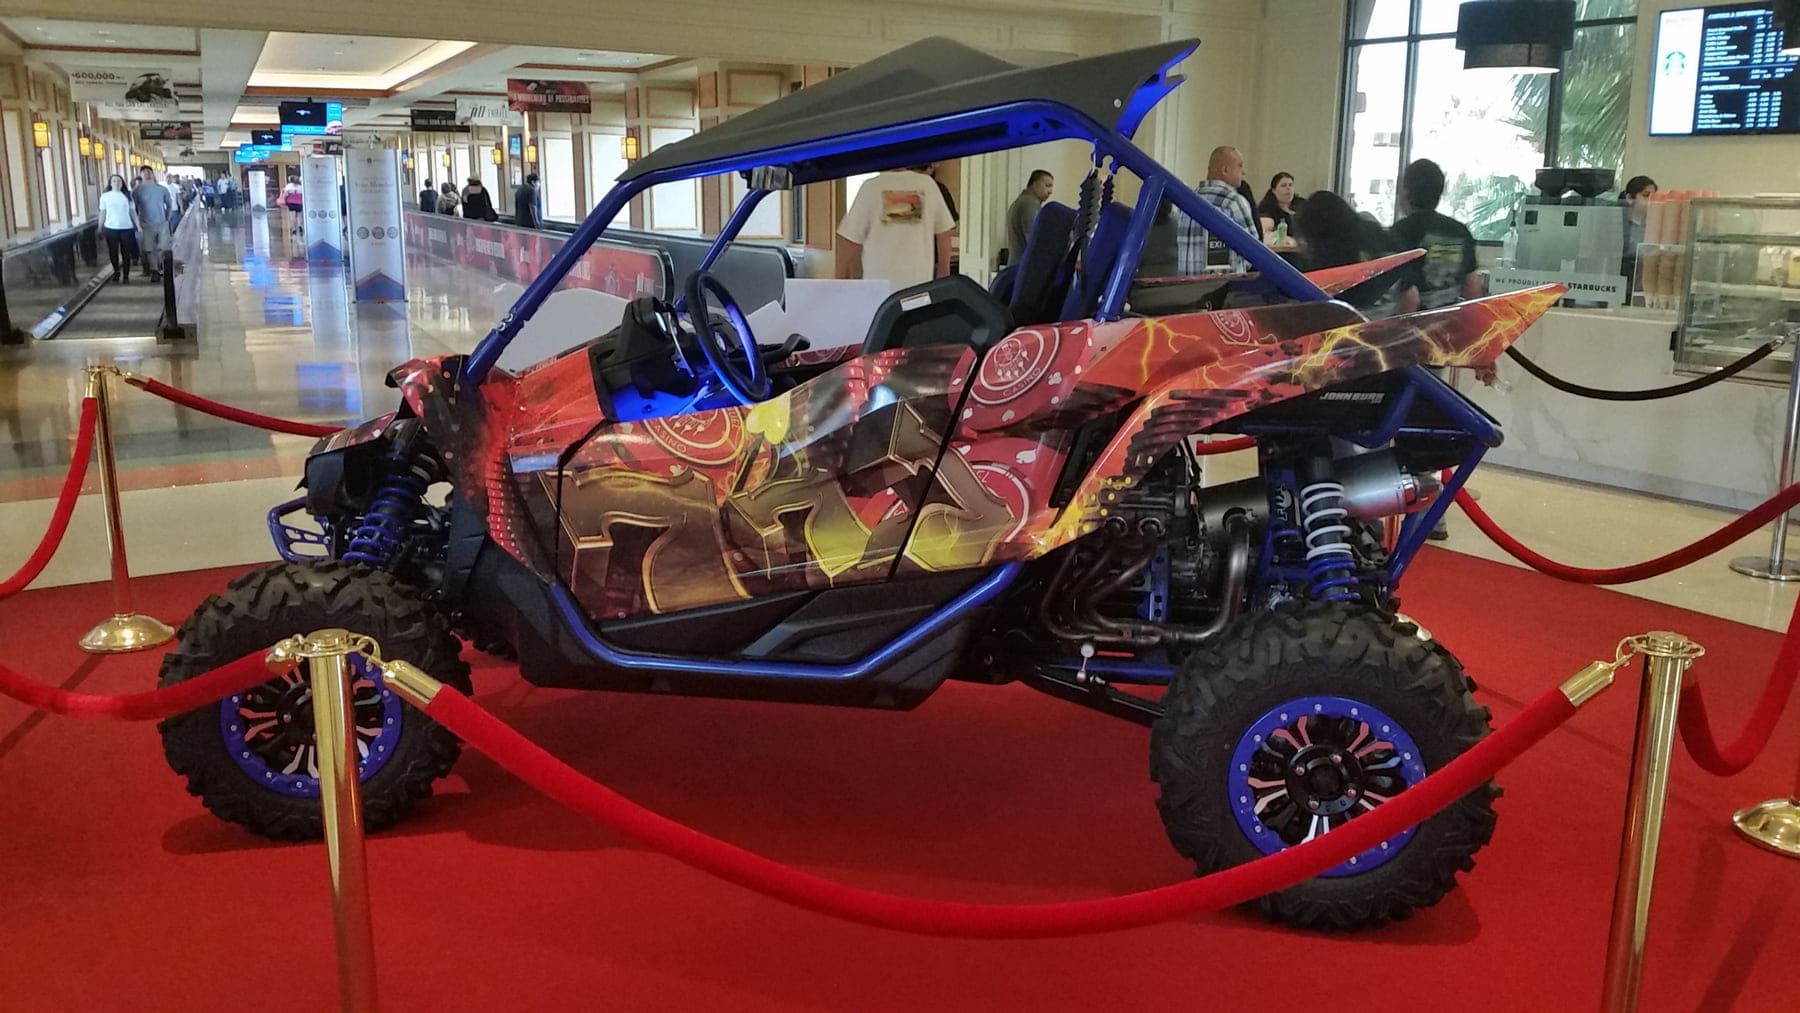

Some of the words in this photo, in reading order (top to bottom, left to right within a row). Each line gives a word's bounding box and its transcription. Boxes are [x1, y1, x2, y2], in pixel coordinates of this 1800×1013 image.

[1567, 282, 1616, 293] STARBUCKS
[1002, 367, 1041, 397] CASINO
[652, 423, 687, 453] ASINO
